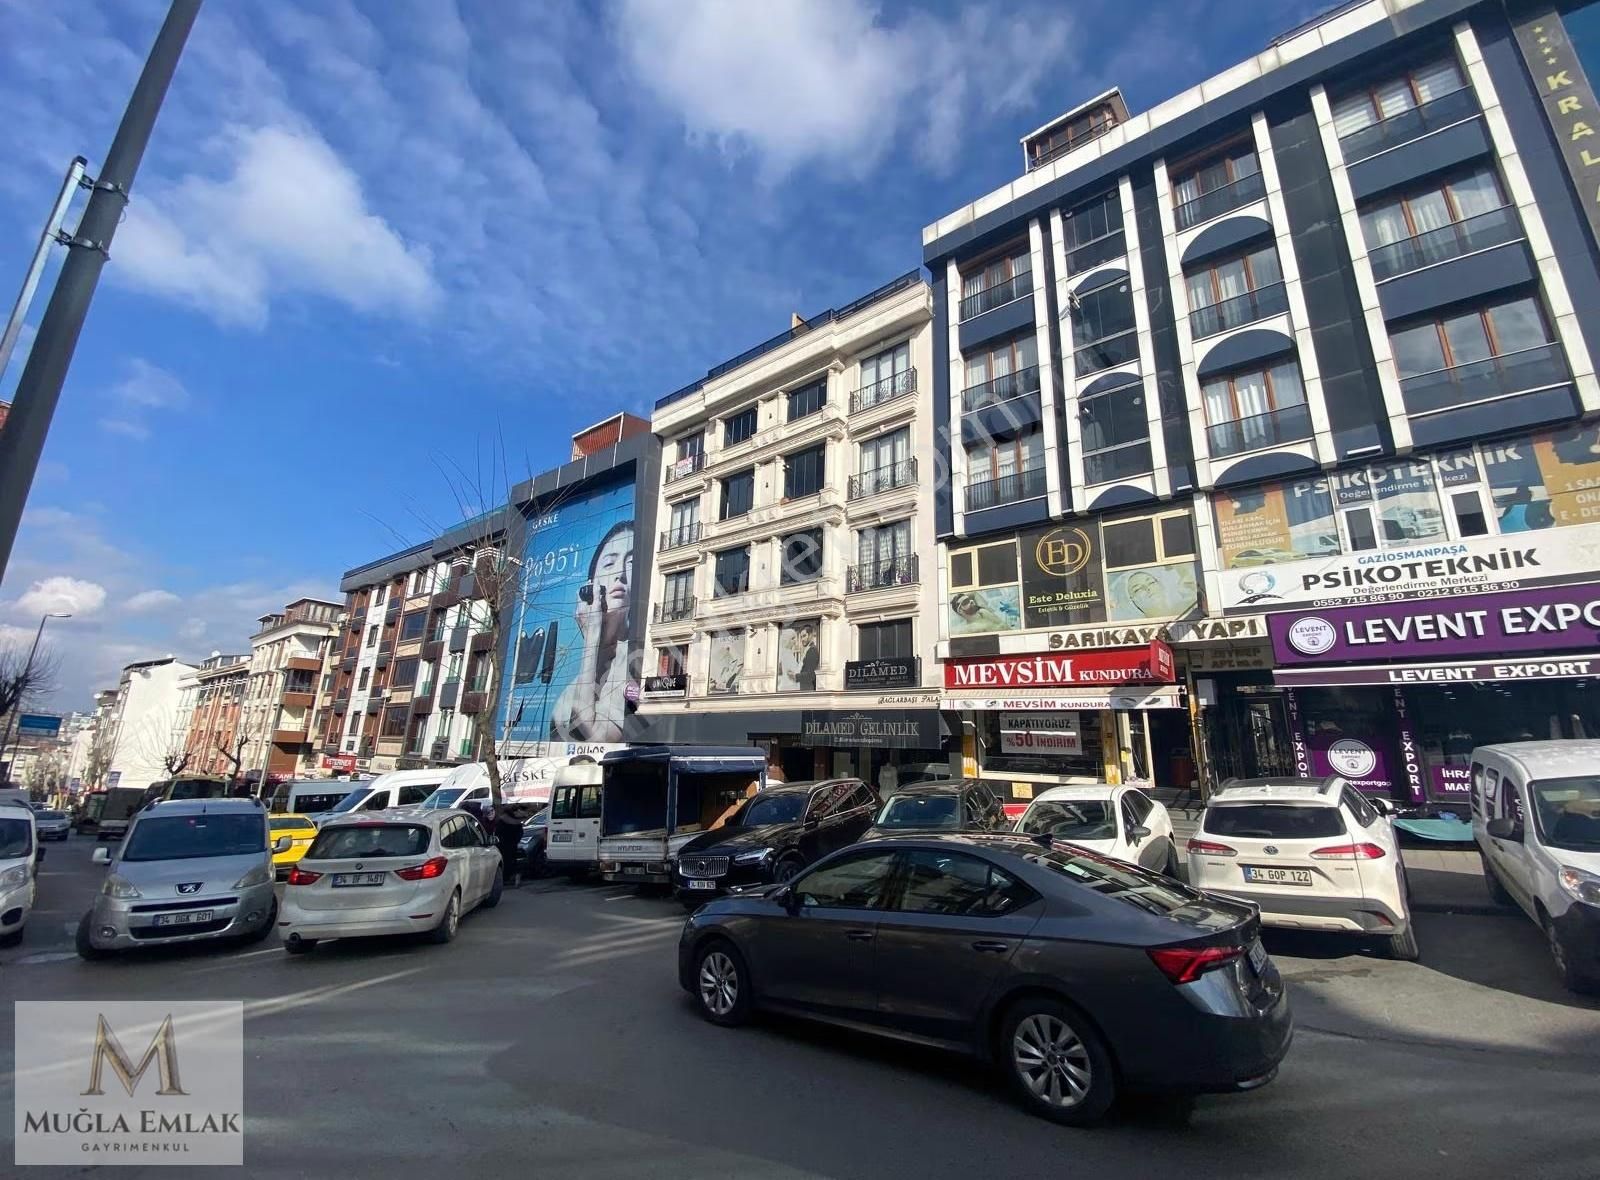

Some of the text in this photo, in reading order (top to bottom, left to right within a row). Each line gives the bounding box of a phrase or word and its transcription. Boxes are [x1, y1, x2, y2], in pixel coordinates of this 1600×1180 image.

[1358, 543, 1468, 565] GAZİOSMANPAŞA
[1302, 547, 1541, 591] PSİKOTEKNİK
[1352, 573, 1488, 595] Değerlendirme Merkezi
[1029, 588, 1098, 604] Este Deluxia
[1313, 598, 1343, 608] 0552
[1345, 595, 1367, 605] 715
[1368, 594, 1386, 603] 86
[1388, 592, 1405, 601] 90
[1417, 588, 1451, 599] 0212
[1454, 585, 1479, 595] 615
[1481, 583, 1500, 592] 86
[1501, 580, 1520, 590] 90
[1049, 619, 1258, 649] SARIKAYA YAPI
[1295, 625, 1327, 633] LEVENT
[1345, 610, 1488, 645] LEVENT
[849, 665, 908, 678] DİLAMED
[953, 656, 1074, 686] MEVSİM
[1079, 668, 1153, 682] KUNDURA
[1389, 662, 1590, 682] LEVENT EXPORT
[1003, 699, 1056, 708] MEVSİM
[806, 720, 920, 736] DİLAMED GELİNLİK
[1008, 719, 1072, 729] KAPATIYORUZ
[1006, 732, 1076, 748] %50 İNDİRİM
[1251, 867, 1310, 883] 34 GOP 122
